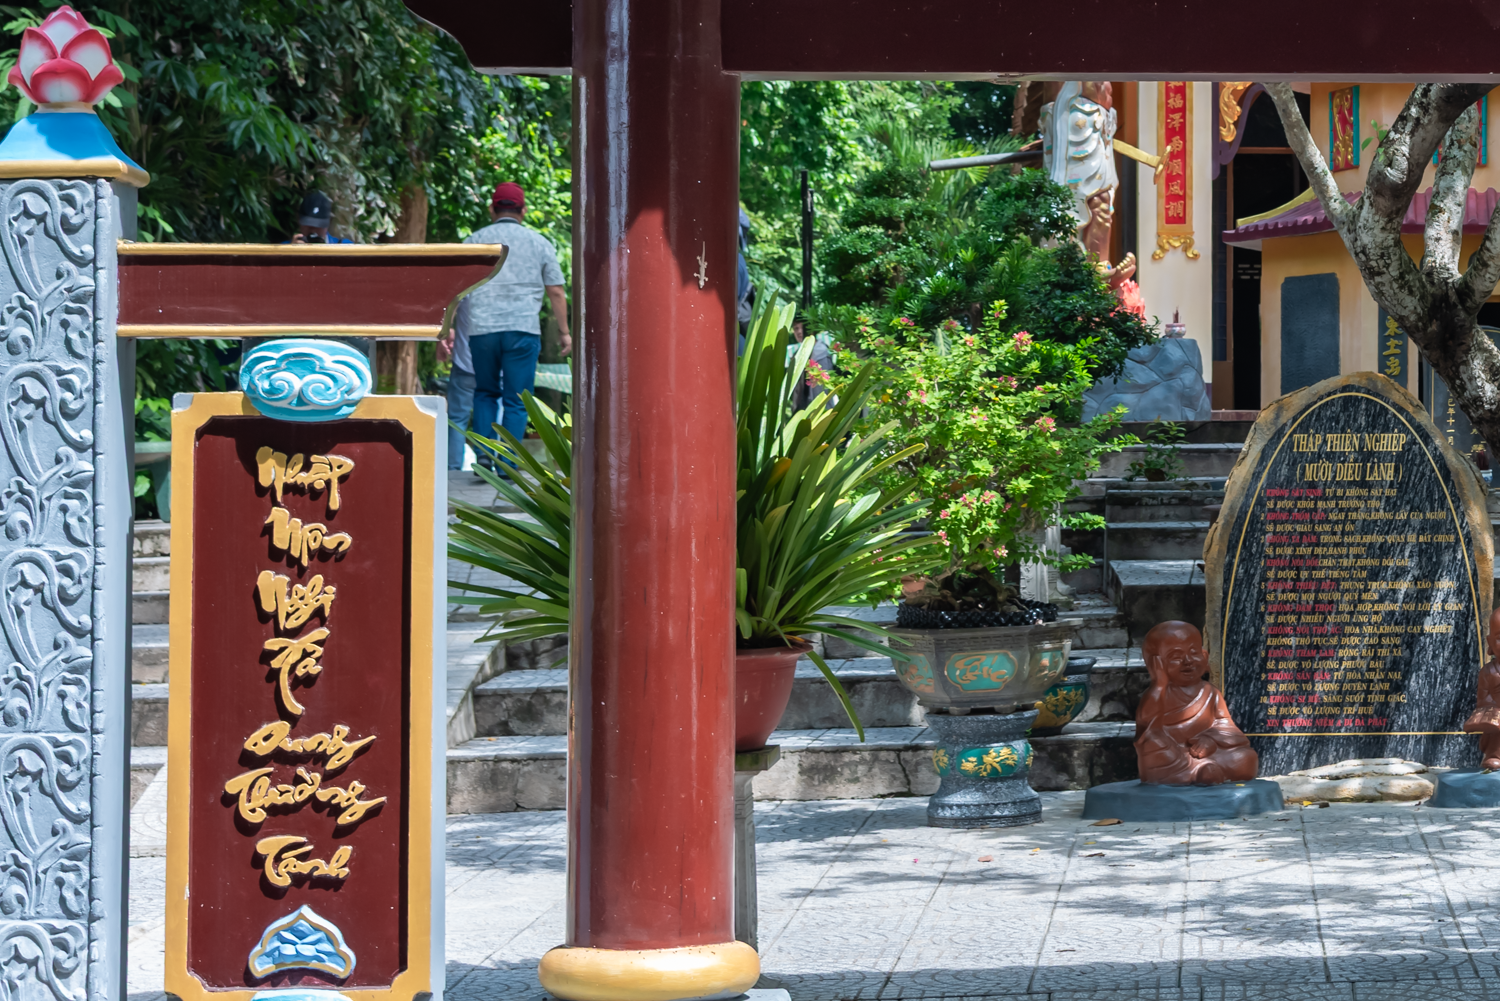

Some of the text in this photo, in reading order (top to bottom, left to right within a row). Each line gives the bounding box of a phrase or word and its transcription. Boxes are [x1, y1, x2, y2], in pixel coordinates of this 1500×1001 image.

[1293, 428, 1407, 456] THẬP THIỆN NGHIỆP
[1304, 458, 1333, 481] MƯỜI
[1365, 458, 1395, 481] LÀNH
[1266, 636, 1292, 645] KHÔNG
[1381, 637, 1400, 645] SANG
[1266, 719, 1280, 727] XIN
